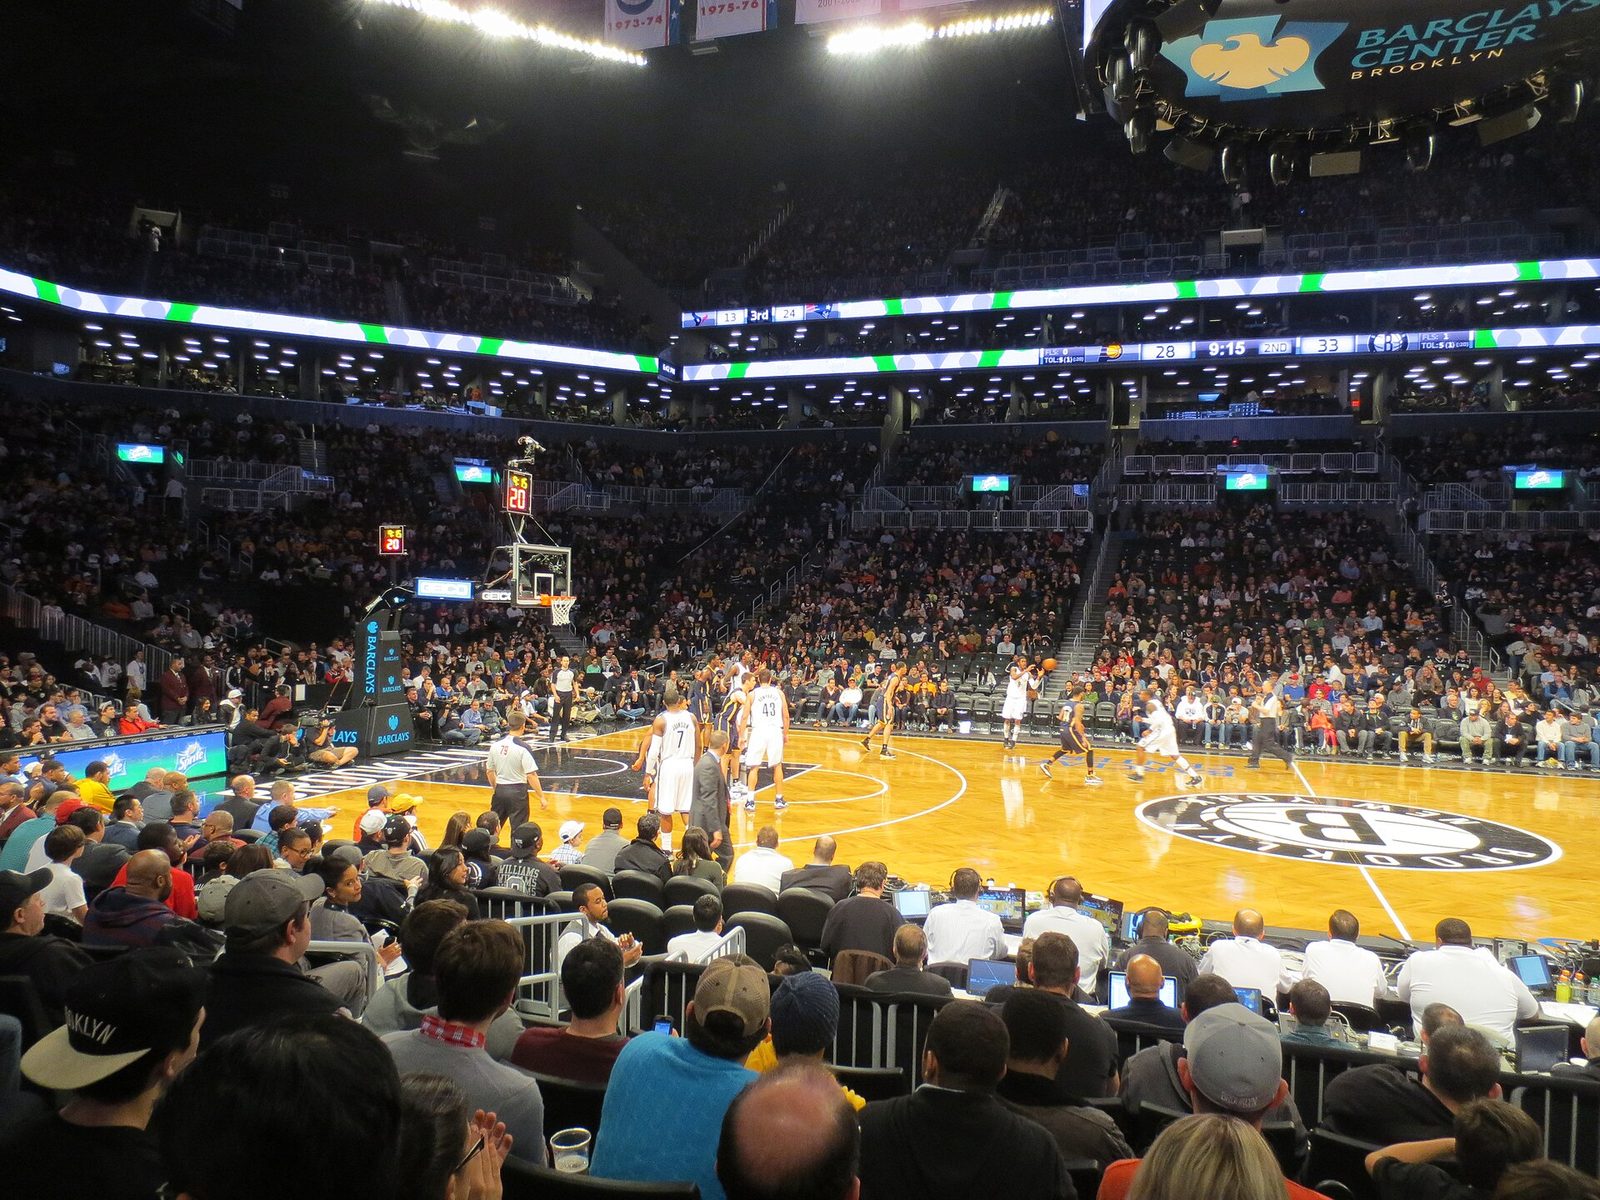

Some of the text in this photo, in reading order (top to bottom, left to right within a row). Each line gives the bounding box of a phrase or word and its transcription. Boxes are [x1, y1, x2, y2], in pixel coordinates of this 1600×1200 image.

[701, 0, 759, 17] 1975-76
[608, 14, 663, 32] 1973-74
[1351, 24, 1537, 68] CENTER
[1351, 48, 1504, 80] BROOKLYN
[724, 309, 796, 323] 13 3rd 24
[1155, 338, 1339, 359] 28 9:15 2ND 33
[509, 487, 526, 510] 20
[386, 538, 400, 551] 20
[365, 635, 377, 694] BARCLAYS
[382, 685, 402, 693] BARCLAYS
[762, 702, 777, 718] 43
[331, 730, 358, 744] LAYS
[377, 731, 410, 745] BARCLAYS
[677, 730, 685, 749] 7
[178, 750, 205, 771] Sprite
[1353, 803, 1480, 825] NEW
[1166, 822, 1537, 868] BROOKLYN
[499, 863, 540, 879] WILLIAMS
